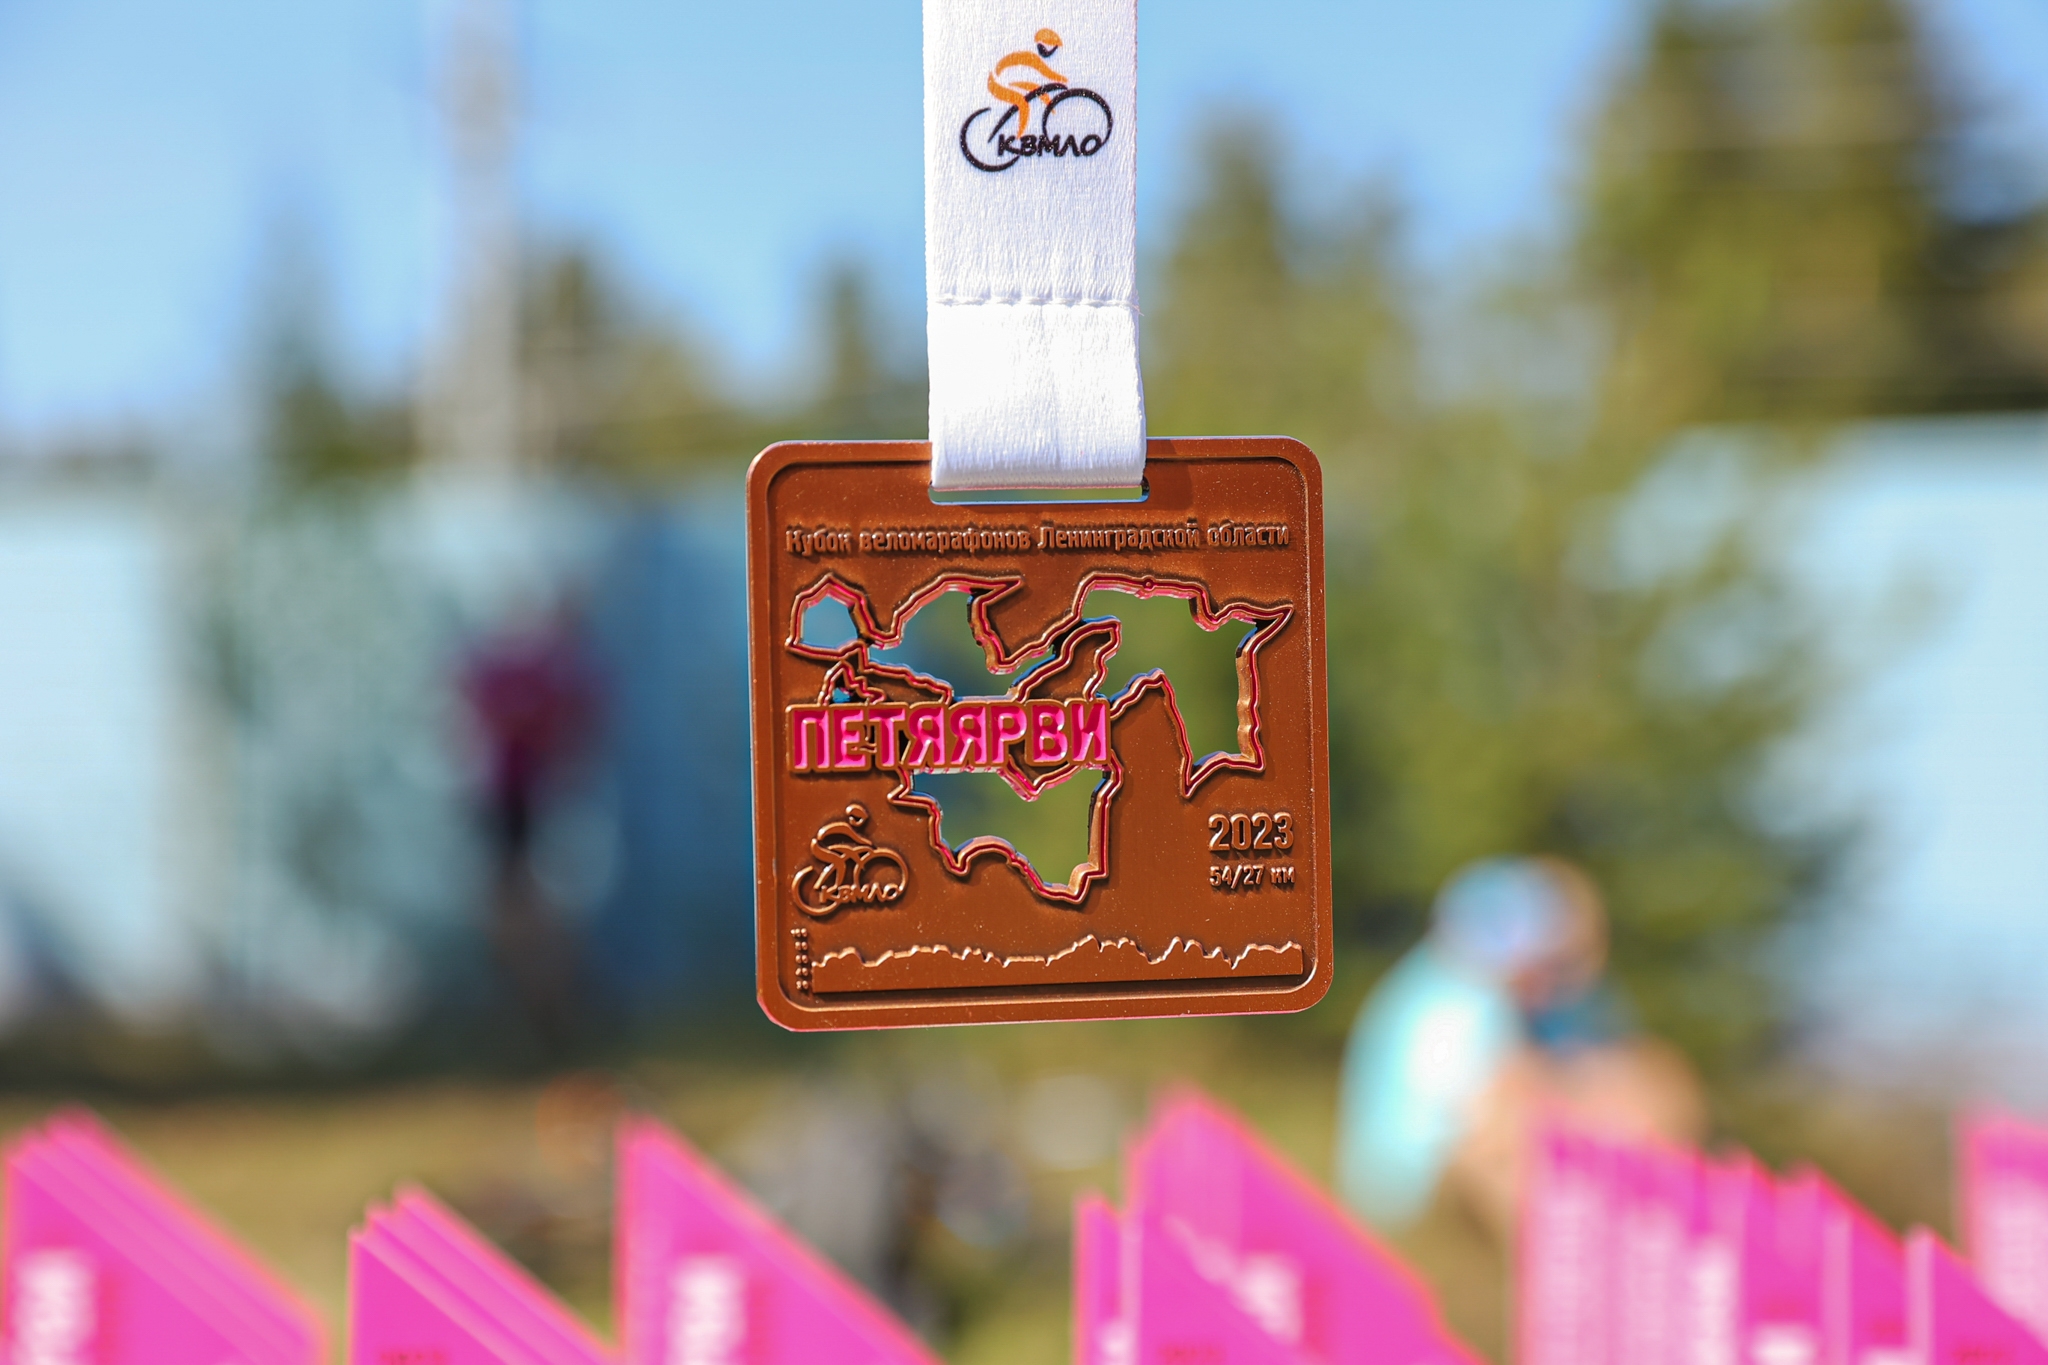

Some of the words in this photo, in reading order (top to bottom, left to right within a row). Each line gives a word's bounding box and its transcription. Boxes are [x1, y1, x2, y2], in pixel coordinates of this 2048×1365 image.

[786, 528, 850, 556] Кубок
[859, 527, 1031, 554] веломарафонов
[1037, 522, 1200, 551] Ленинградской
[1206, 520, 1290, 547] области
[792, 702, 1107, 770] ПЕТЯЯРВИ
[1208, 812, 1294, 851] 2023
[1209, 864, 1265, 890] 54/27
